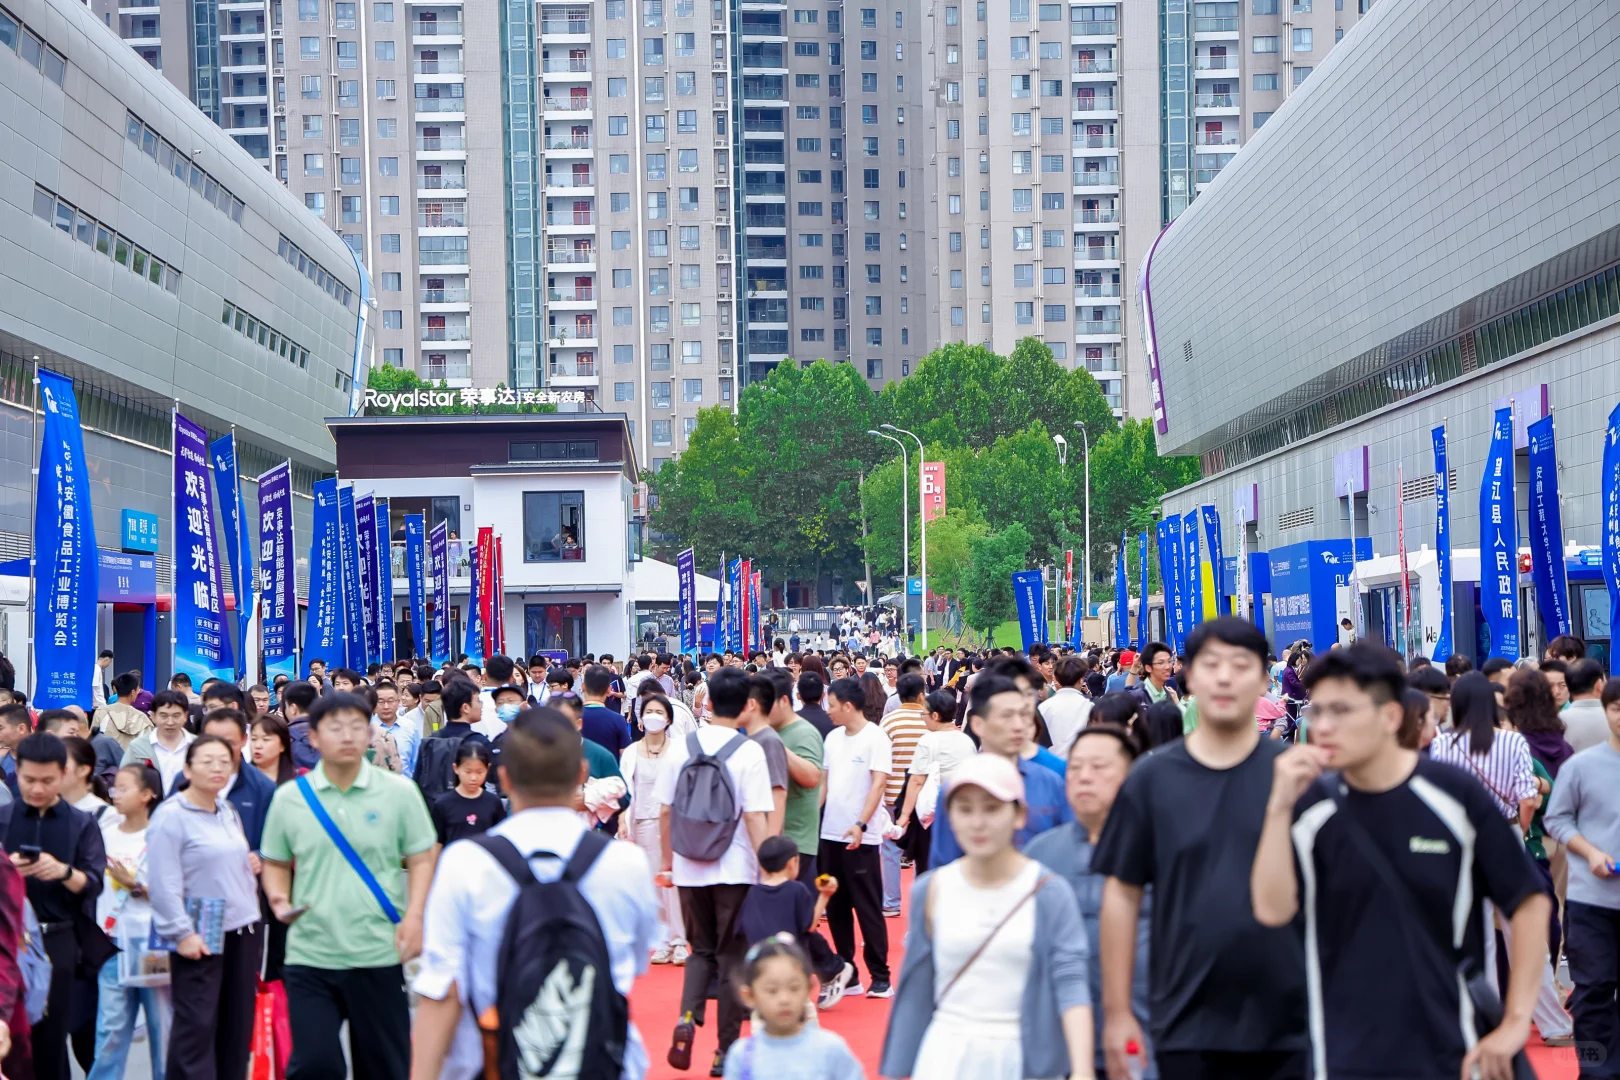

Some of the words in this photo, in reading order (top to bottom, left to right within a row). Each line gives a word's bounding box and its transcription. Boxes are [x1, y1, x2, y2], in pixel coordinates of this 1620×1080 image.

[364, 388, 456, 413] Royalstar
[460, 387, 516, 406] 荣事达
[523, 390, 586, 405] 安全新农房
[184, 470, 210, 610] 欢迎光临
[261, 510, 275, 619] 欢迎光临
[275, 506, 285, 618] 荣事达智能房屋展区
[1491, 457, 1513, 618] 望江县人民政府
